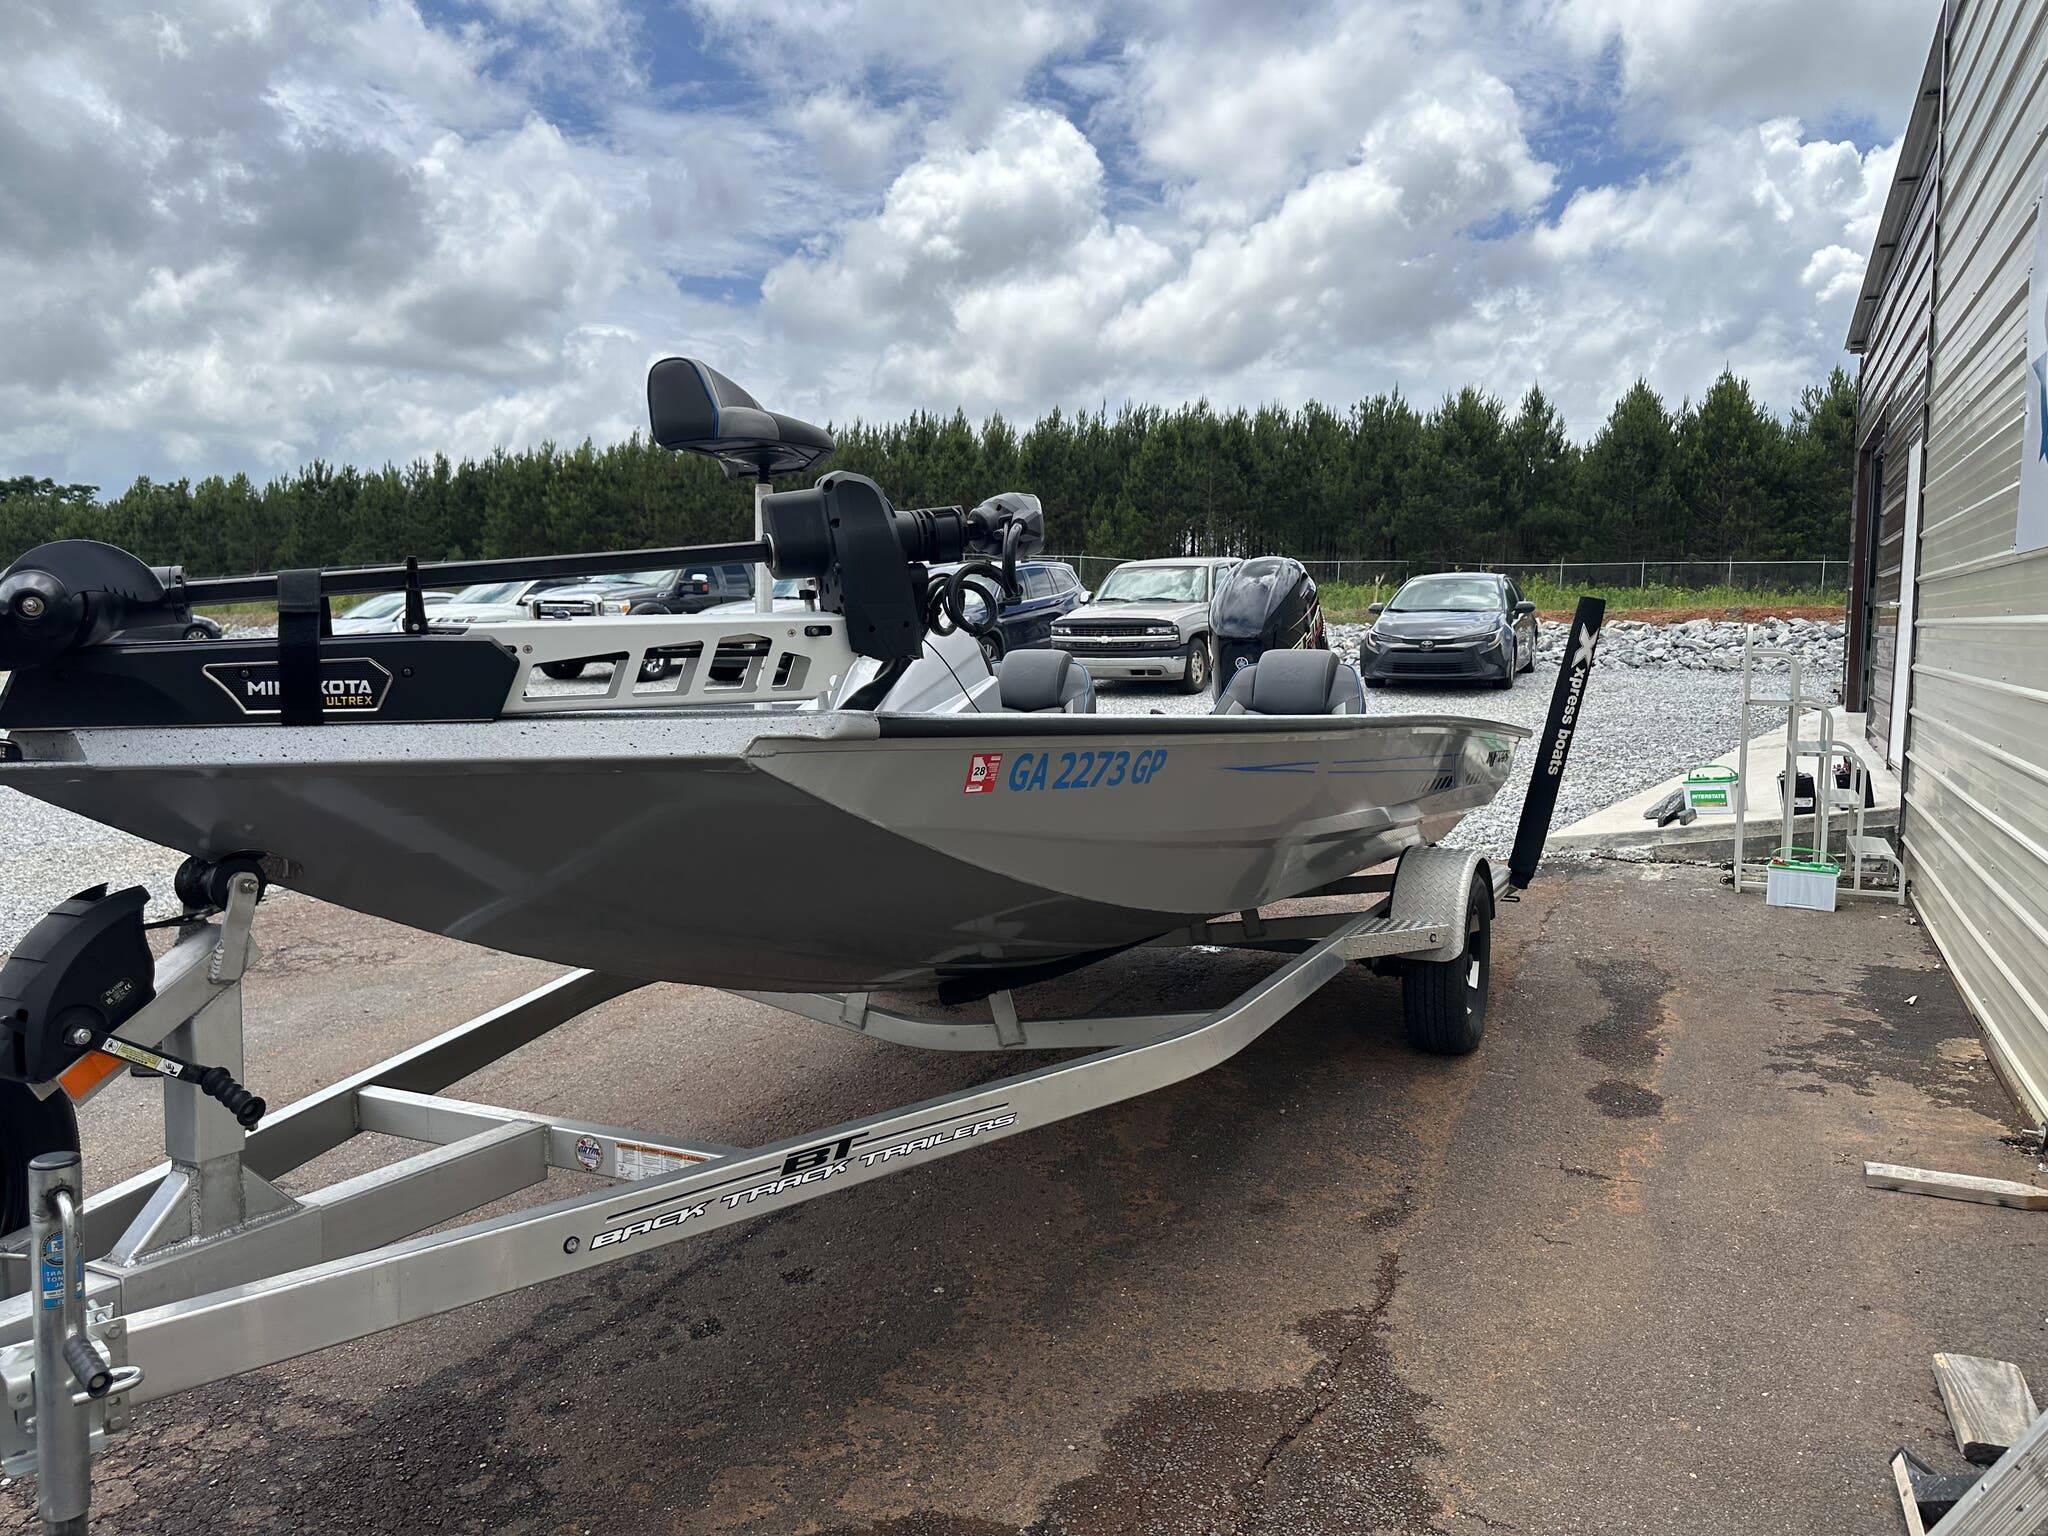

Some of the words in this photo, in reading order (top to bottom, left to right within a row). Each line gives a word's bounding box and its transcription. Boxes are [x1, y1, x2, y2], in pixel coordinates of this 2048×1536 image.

[326, 696, 373, 706] ULTREX
[1561, 666, 1586, 725] xpress
[973, 766, 986, 776] 28
[1008, 752, 1050, 792] GA
[1052, 750, 1131, 790] 2273
[1131, 748, 1168, 785] GP
[1548, 728, 1571, 776] boats
[780, 1131, 869, 1177] BT
[589, 1198, 715, 1250] BACK
[720, 1157, 855, 1209] TRACK
[859, 1112, 1017, 1167] TRAILERS
